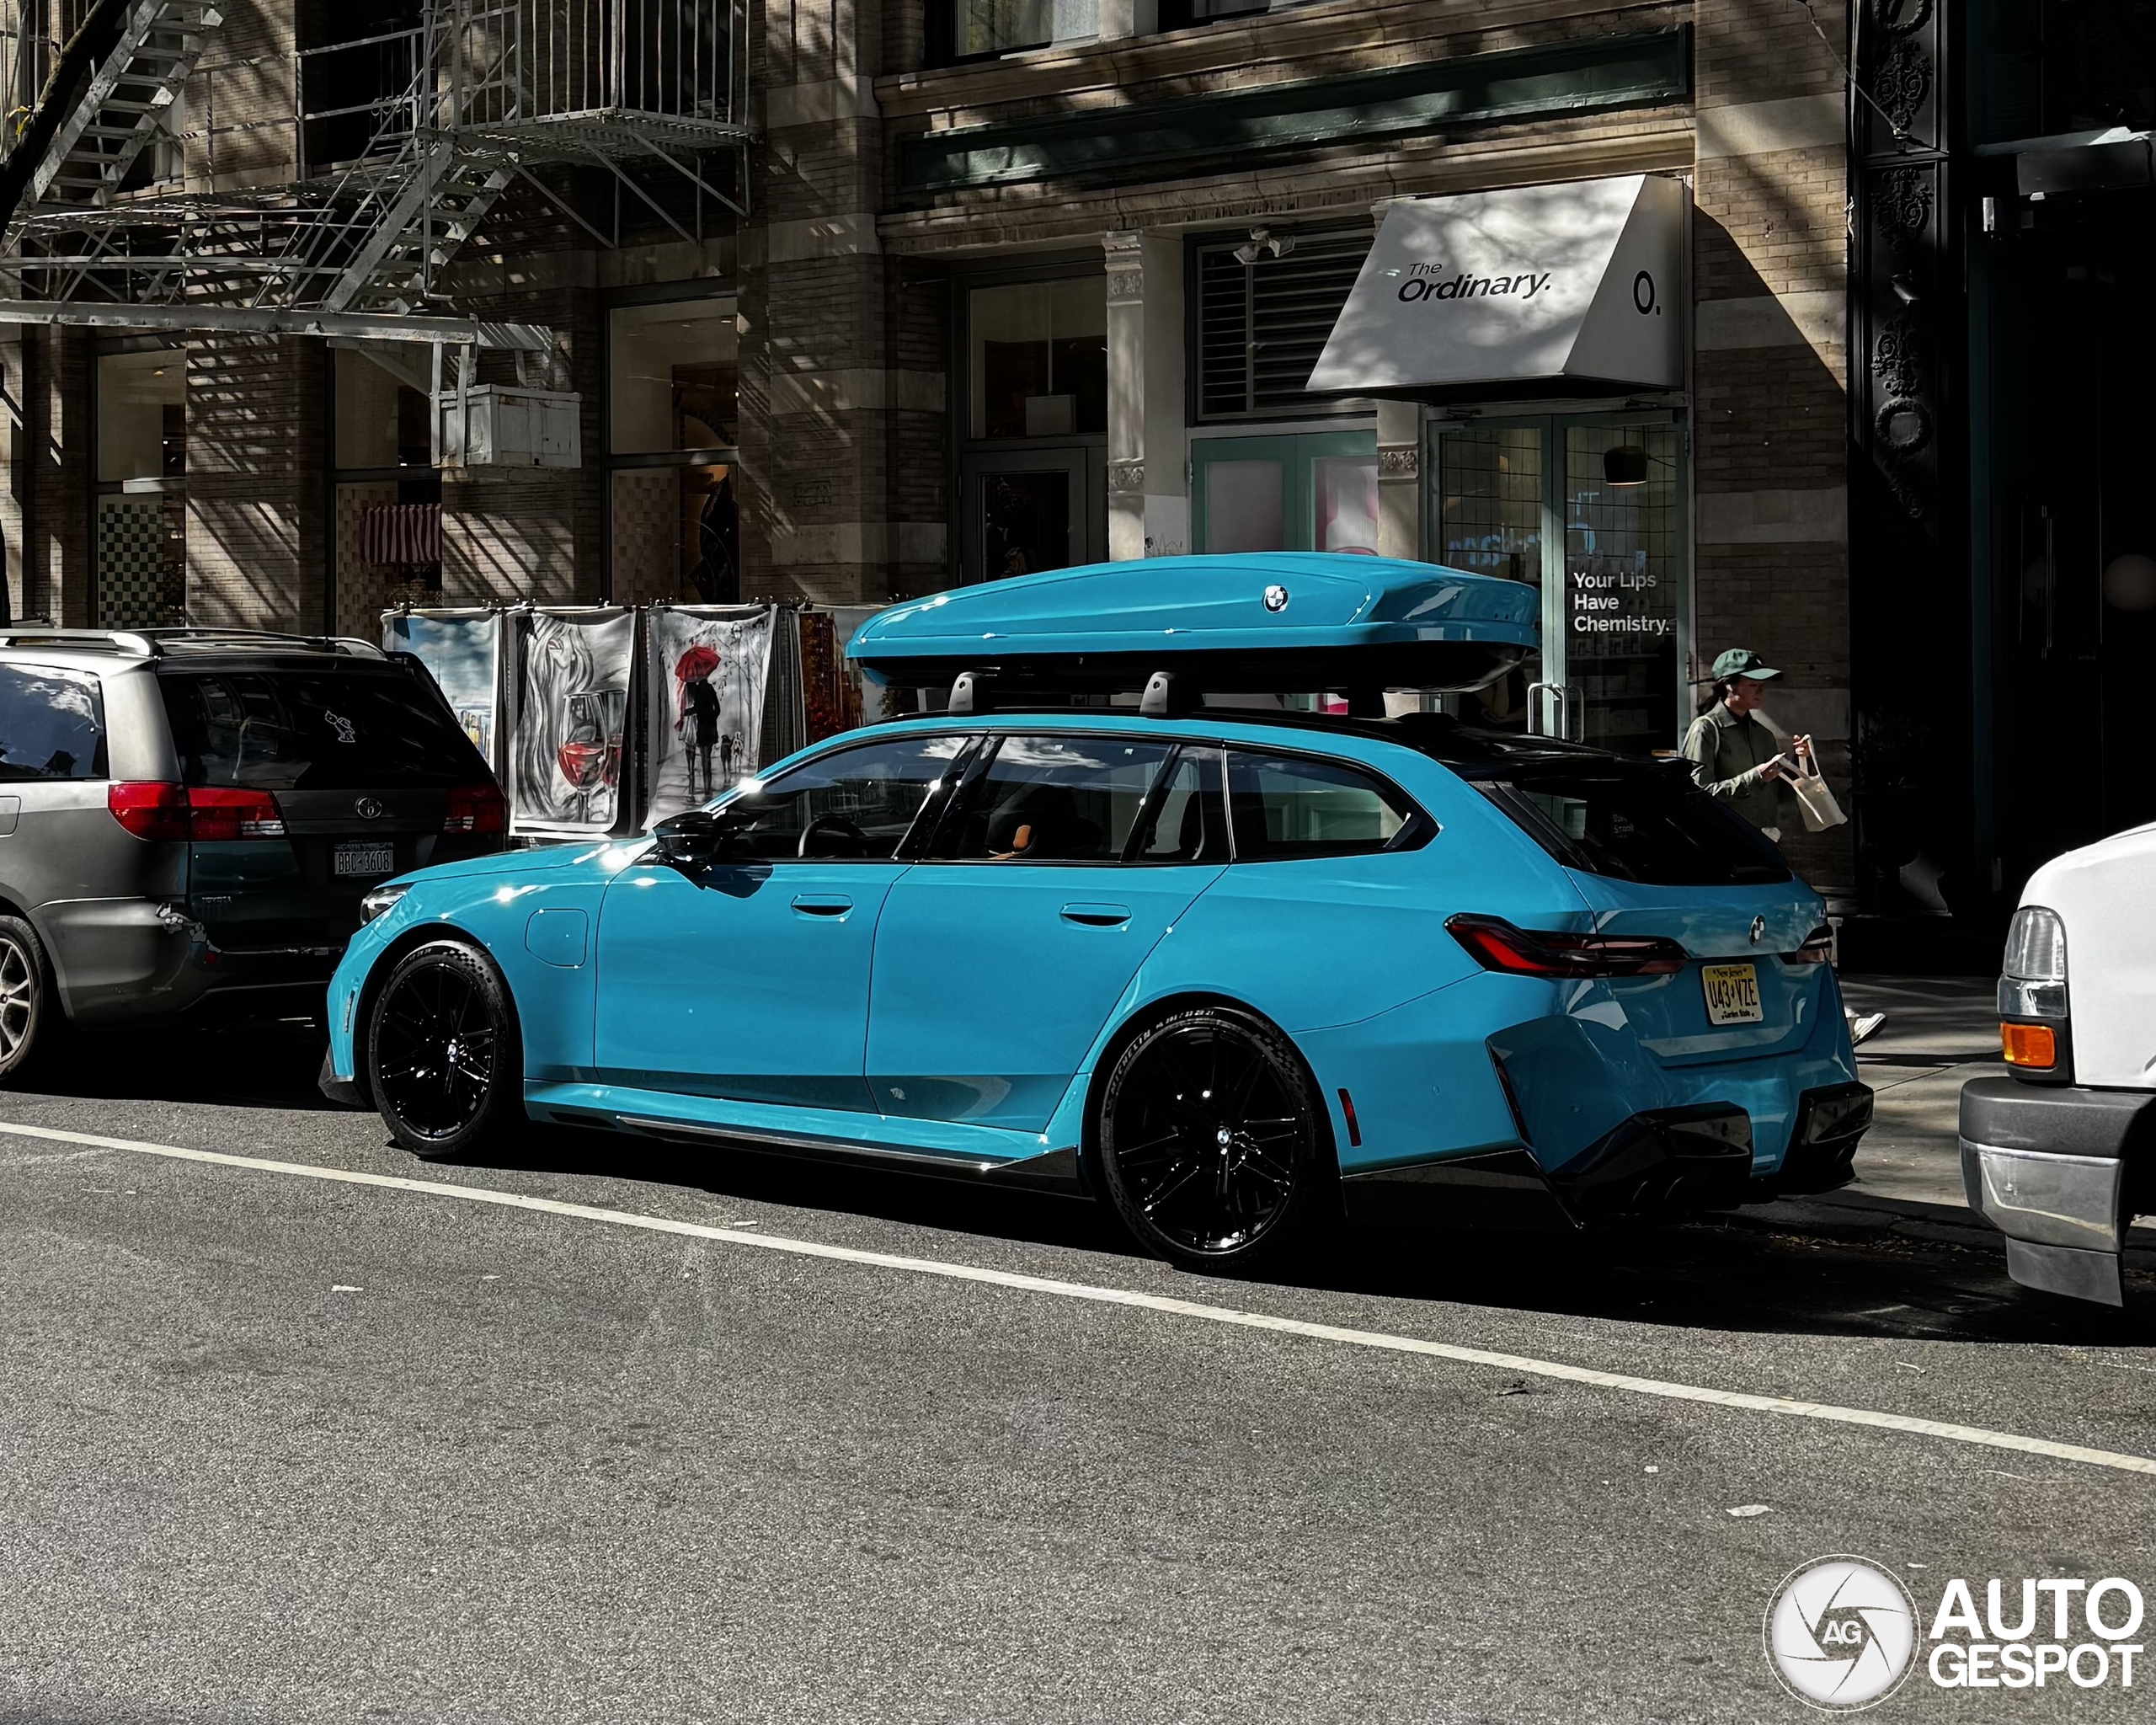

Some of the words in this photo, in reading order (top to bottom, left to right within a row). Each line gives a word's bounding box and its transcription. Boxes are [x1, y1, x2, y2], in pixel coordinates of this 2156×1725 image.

[1409, 262, 1442, 275] The
[1398, 272, 1550, 302] Ordinary.
[1633, 270, 1660, 315] O.
[1573, 572, 1615, 589] Your
[1620, 571, 1657, 592] Lips
[1574, 593, 1620, 611] Have
[1573, 615, 1670, 636] Chemistry.
